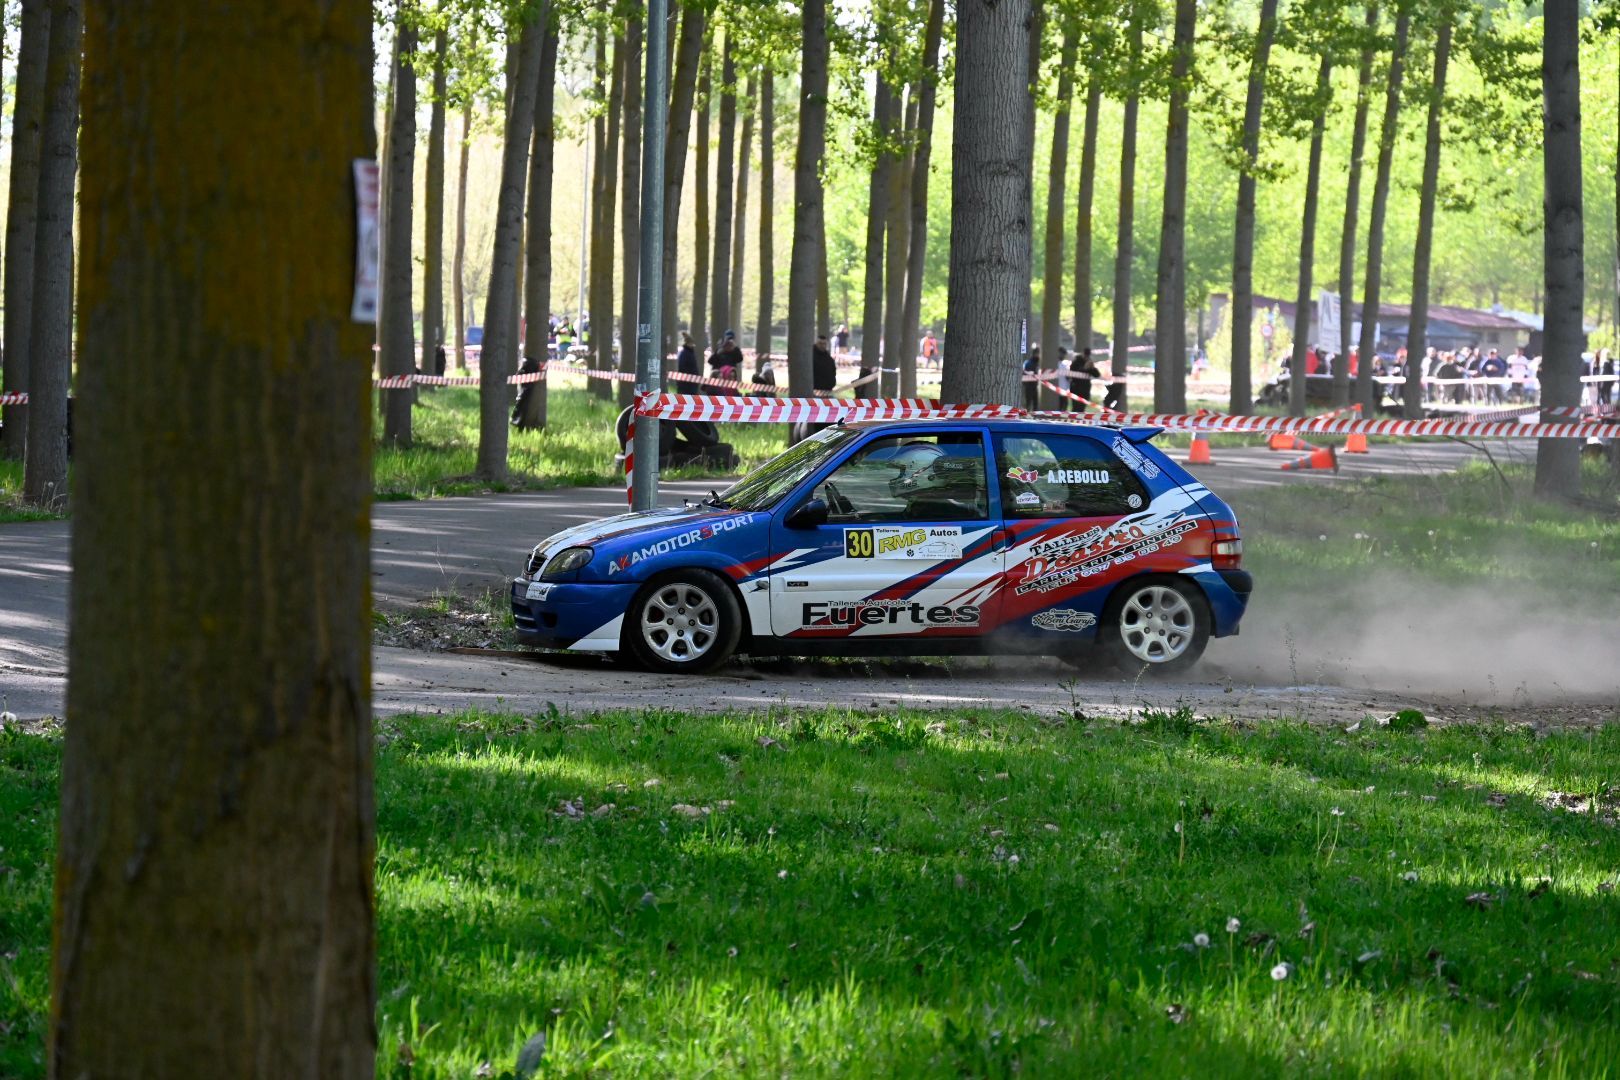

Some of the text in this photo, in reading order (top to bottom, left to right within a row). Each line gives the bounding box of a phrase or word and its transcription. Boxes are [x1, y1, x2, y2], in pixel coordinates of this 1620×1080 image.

[1047, 469, 1110, 484] A.REBOLLO
[848, 531, 872, 557] 30
[879, 529, 927, 554] RMG
[930, 528, 958, 537] Autos
[1029, 526, 1101, 557] TALLERES
[1133, 523, 1194, 550] PINTURA
[802, 602, 981, 625] Fuertes
